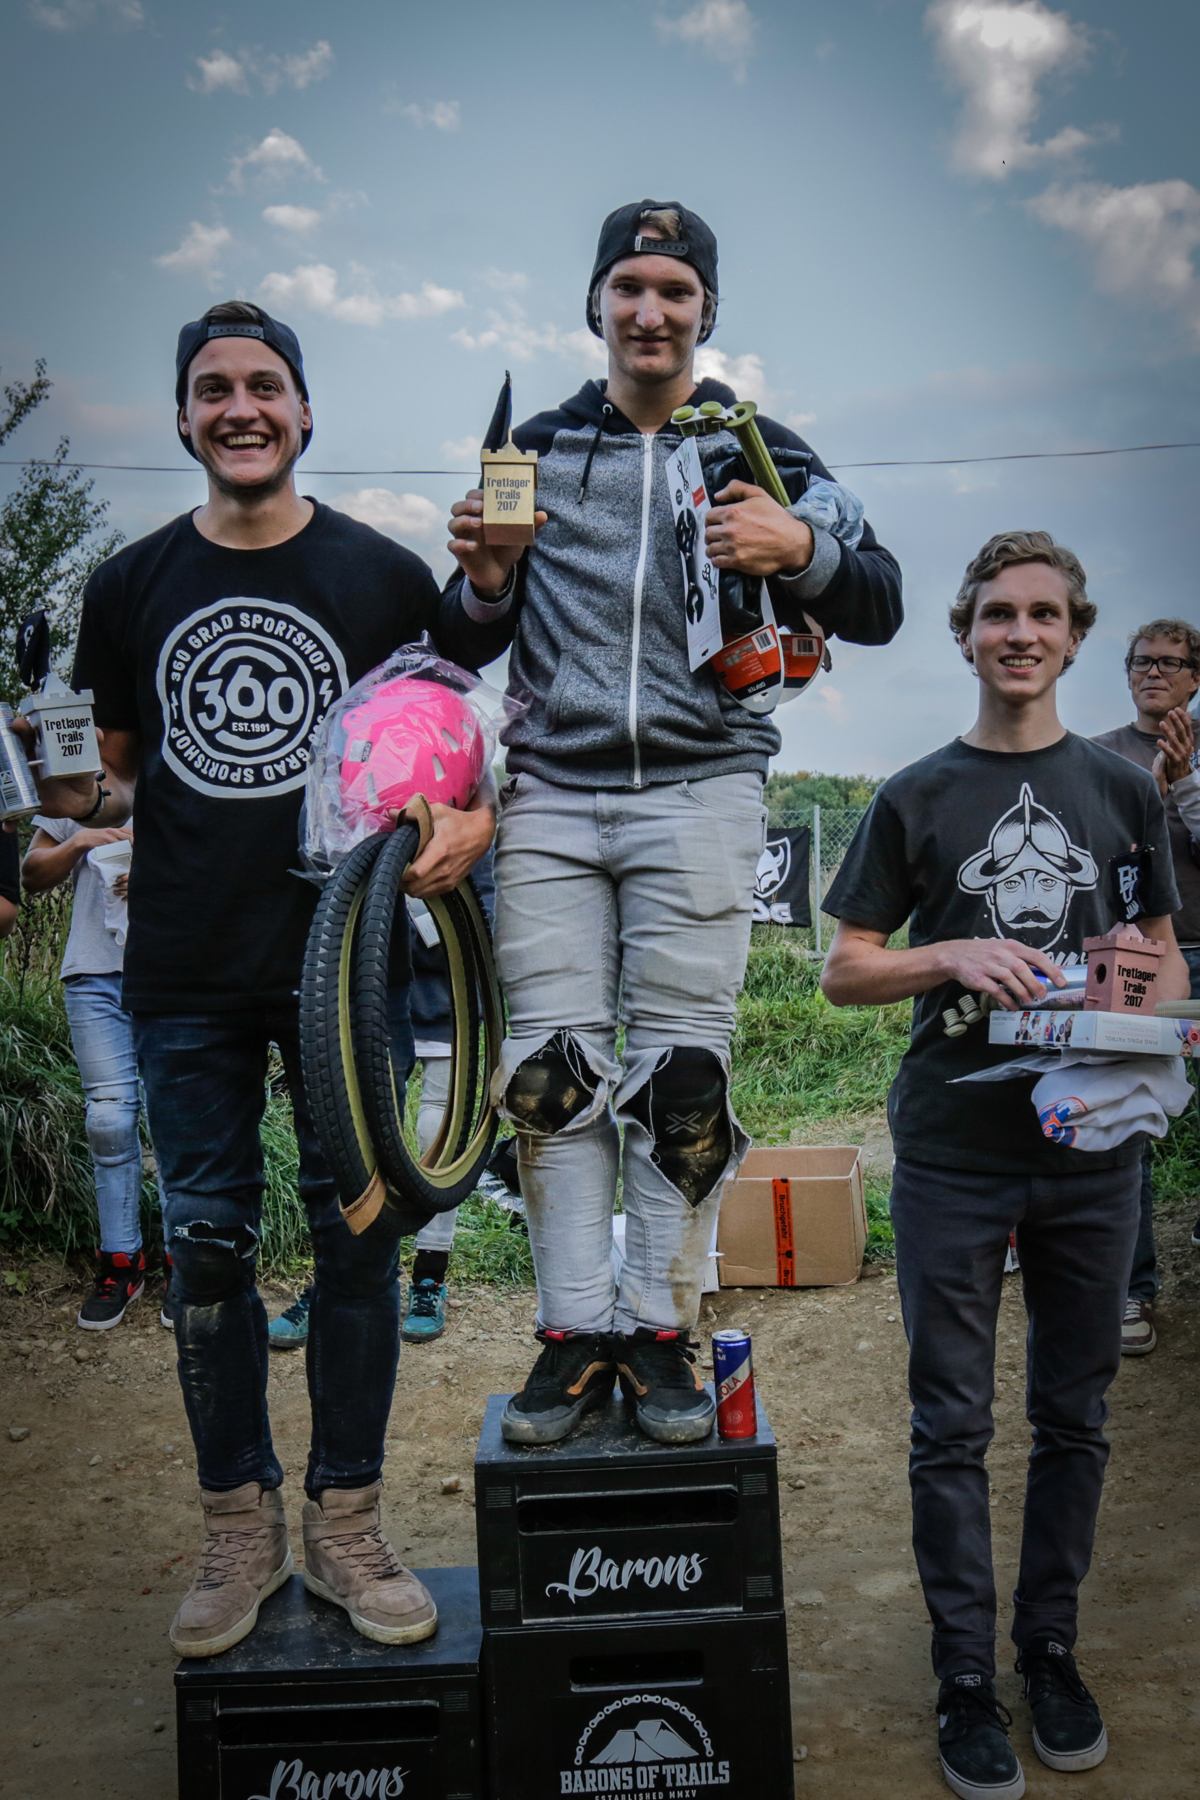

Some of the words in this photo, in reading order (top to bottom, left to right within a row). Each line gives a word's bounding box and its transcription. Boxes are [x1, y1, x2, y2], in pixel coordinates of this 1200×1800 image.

[486, 477, 530, 489] Tretlager
[495, 489, 521, 500] Trails
[497, 501, 518, 511] 2017
[171, 649, 192, 682] 360
[187, 614, 234, 649] GRAD
[239, 612, 331, 674] SPORTSHOP
[195, 664, 305, 731] 360
[44, 717, 91, 731] Tretlager
[231, 721, 270, 733] EST.1991
[56, 731, 84, 744] Trails
[61, 743, 83, 757] 2017
[169, 727, 254, 783] SPORTSHOP
[1117, 964, 1157, 982] Tretlager
[1123, 980, 1147, 995] Trails
[1124, 994, 1143, 1007] 2017
[1105, 1035, 1126, 1043] PATROL
[778, 1194, 788, 1240] Bruchgefahr
[545, 1546, 708, 1604] Barons
[247, 1758, 411, 1800] Barons
[560, 1767, 633, 1794] BARONS
[636, 1765, 660, 1789] OF
[662, 1761, 730, 1788] TRAILS
[669, 1789, 697, 1799] MMXV
